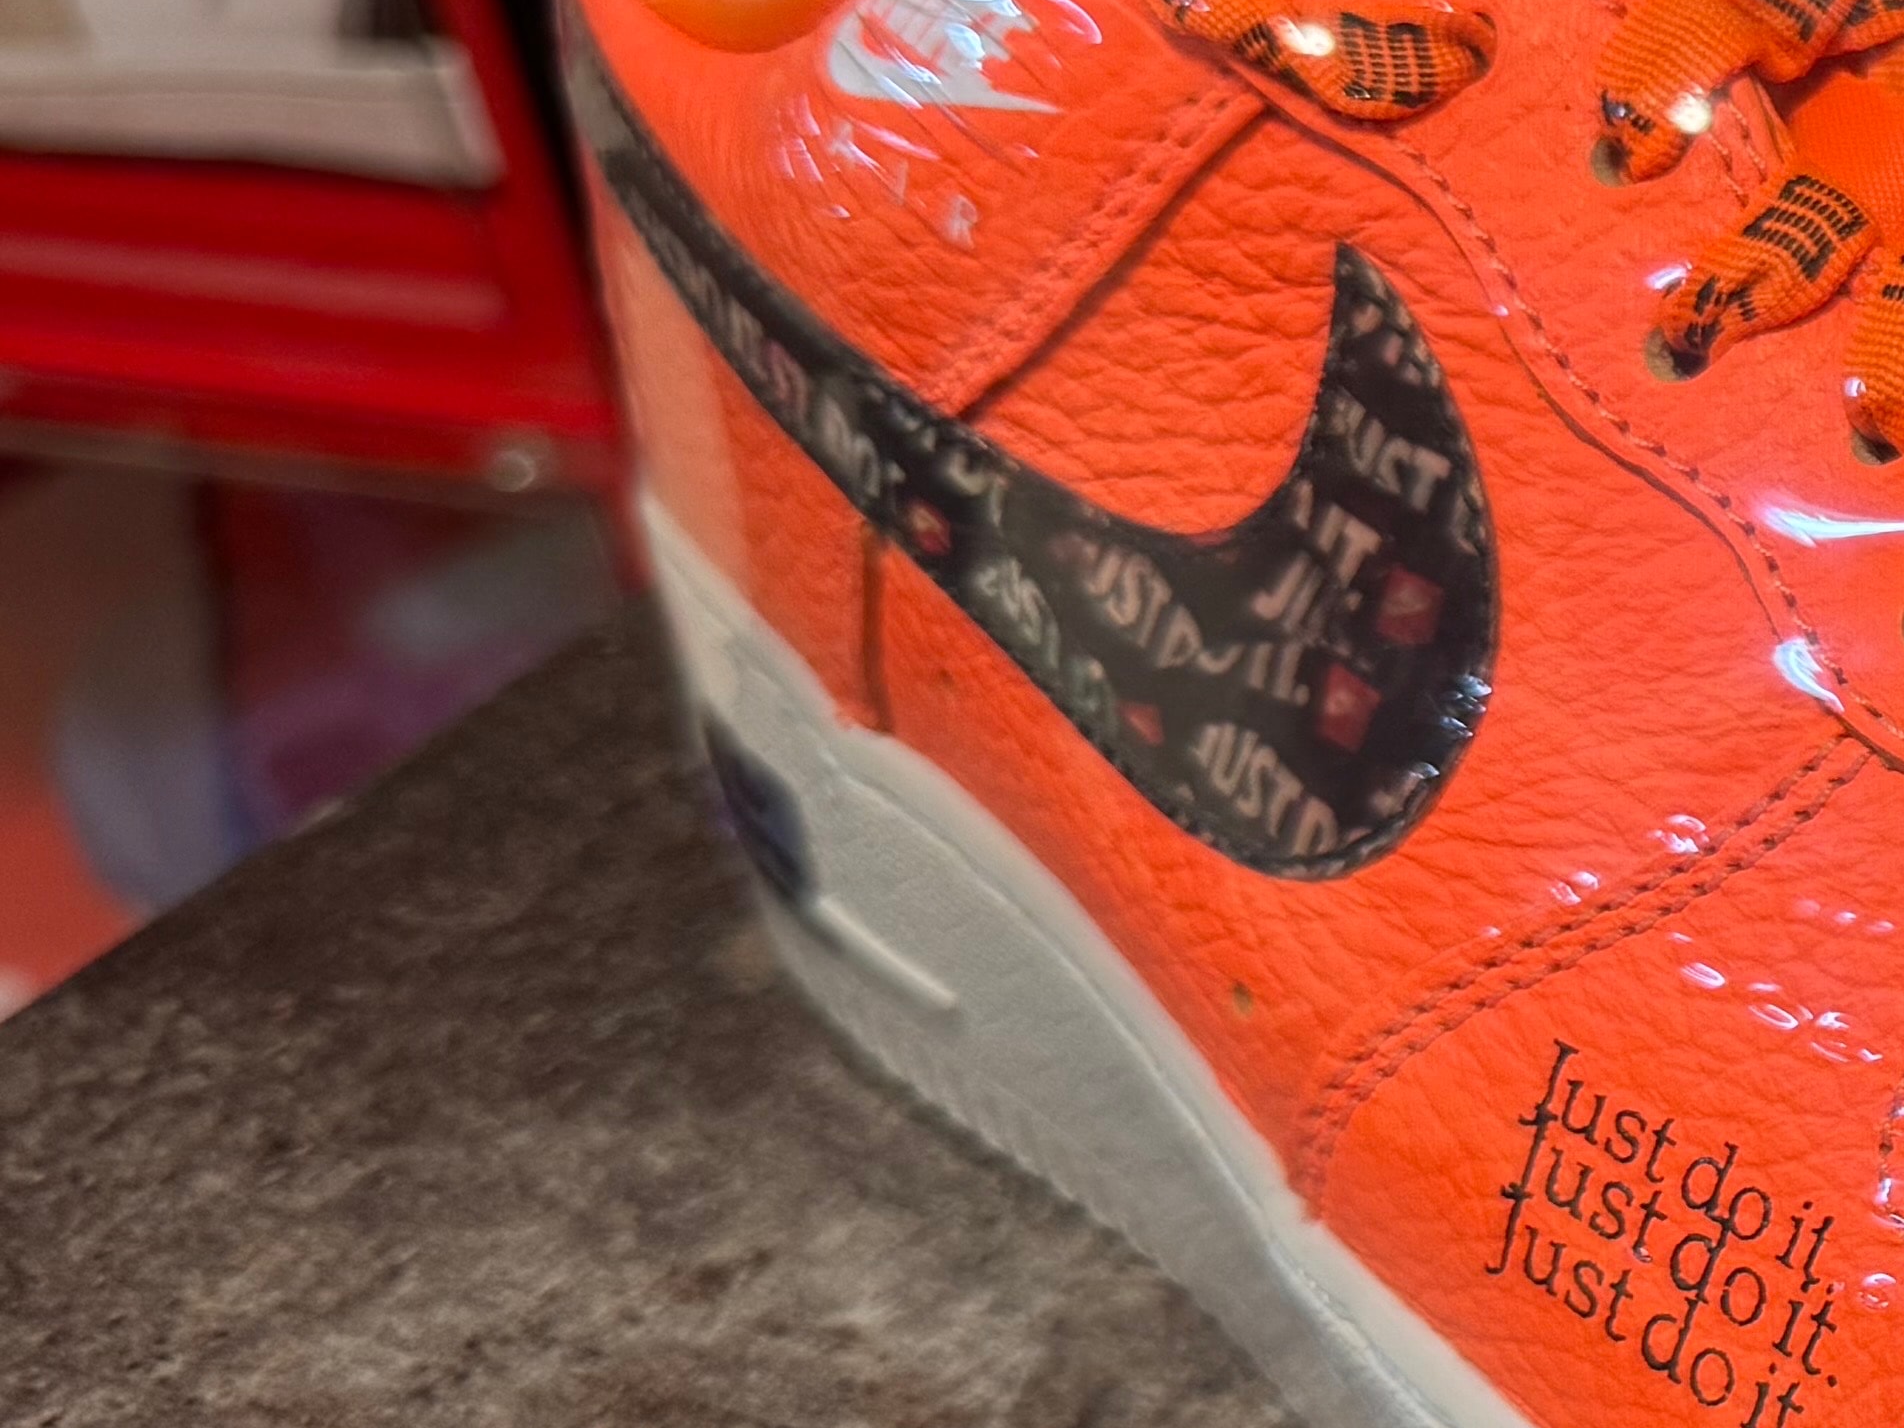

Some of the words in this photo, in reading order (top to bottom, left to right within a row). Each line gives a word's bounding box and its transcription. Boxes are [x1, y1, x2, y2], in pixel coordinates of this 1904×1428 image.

[1741, 173, 1872, 280] DO
[1518, 1038, 1677, 1183] Just
[1680, 1142, 1772, 1240] do
[1485, 1180, 1634, 1343] Just
[1641, 1295, 1736, 1407] do
[1500, 1106, 1669, 1264] Just
[1668, 1214, 1768, 1328] do
[1772, 1281, 1839, 1388] it.
